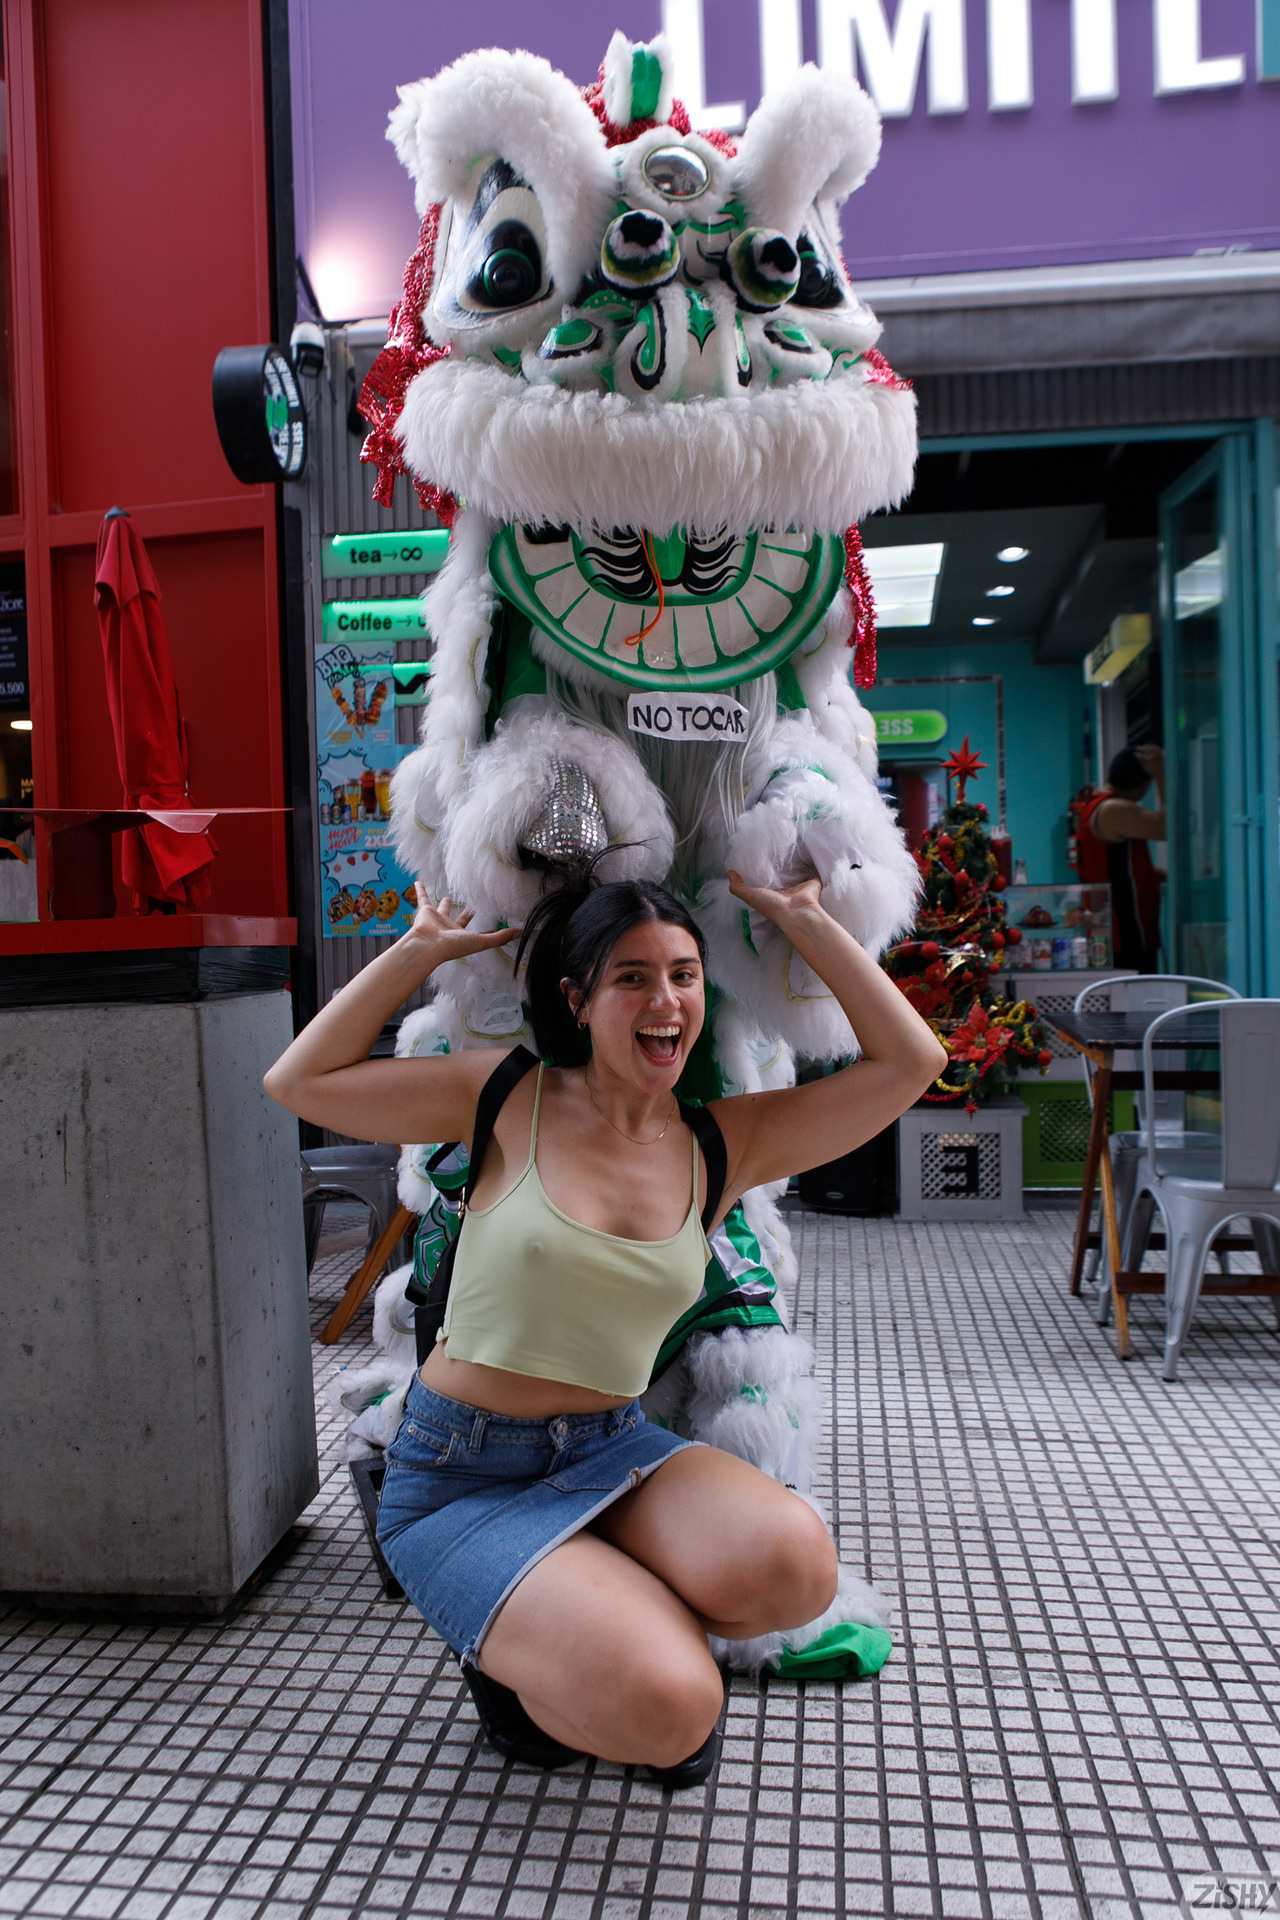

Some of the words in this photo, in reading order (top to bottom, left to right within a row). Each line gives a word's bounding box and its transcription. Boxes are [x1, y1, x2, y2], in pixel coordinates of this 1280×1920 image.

[350, 548, 382, 563] tea
[338, 613, 392, 631] Coffee
[315, 645, 353, 680] BBQ
[633, 705, 672, 732] NO
[677, 706, 747, 734] TOCAR
